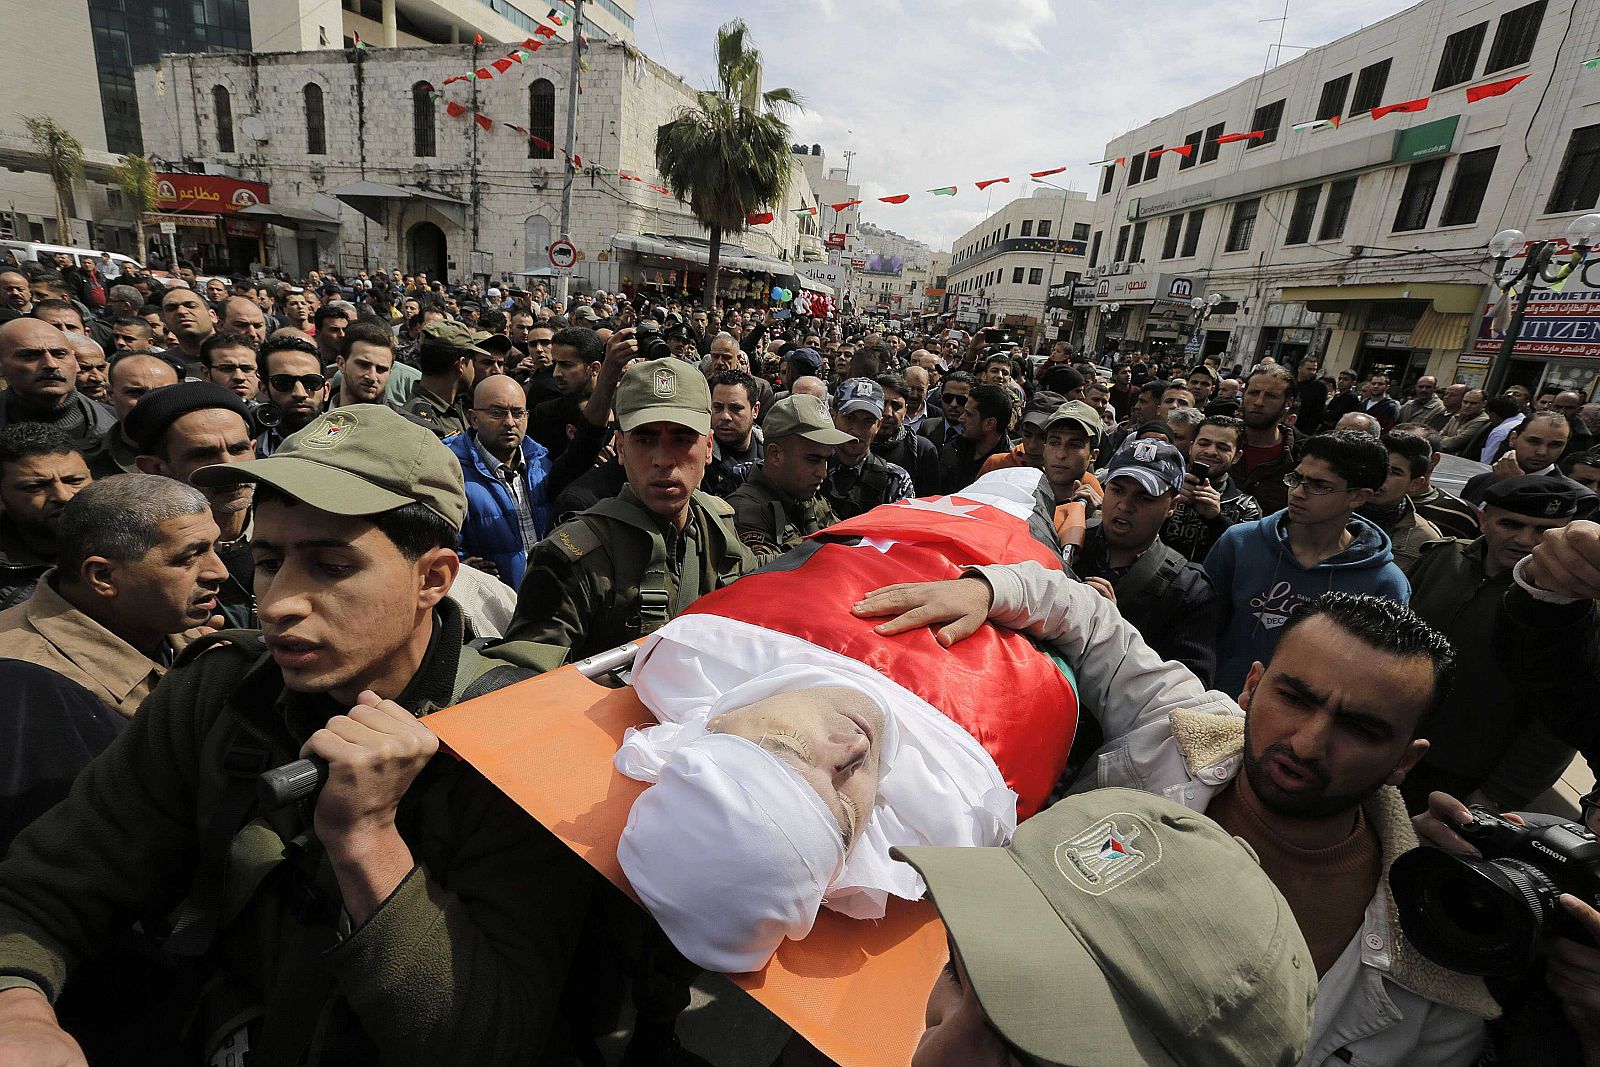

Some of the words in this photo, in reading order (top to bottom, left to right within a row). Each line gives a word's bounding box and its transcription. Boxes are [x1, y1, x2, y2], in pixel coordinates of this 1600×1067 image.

[179, 186, 220, 201] مطاعم
[1509, 291, 1600, 301] TOMETR
[1513, 320, 1600, 340] ITIZE
[1266, 617, 1284, 626] DEC
[1531, 840, 1568, 863] Canon
